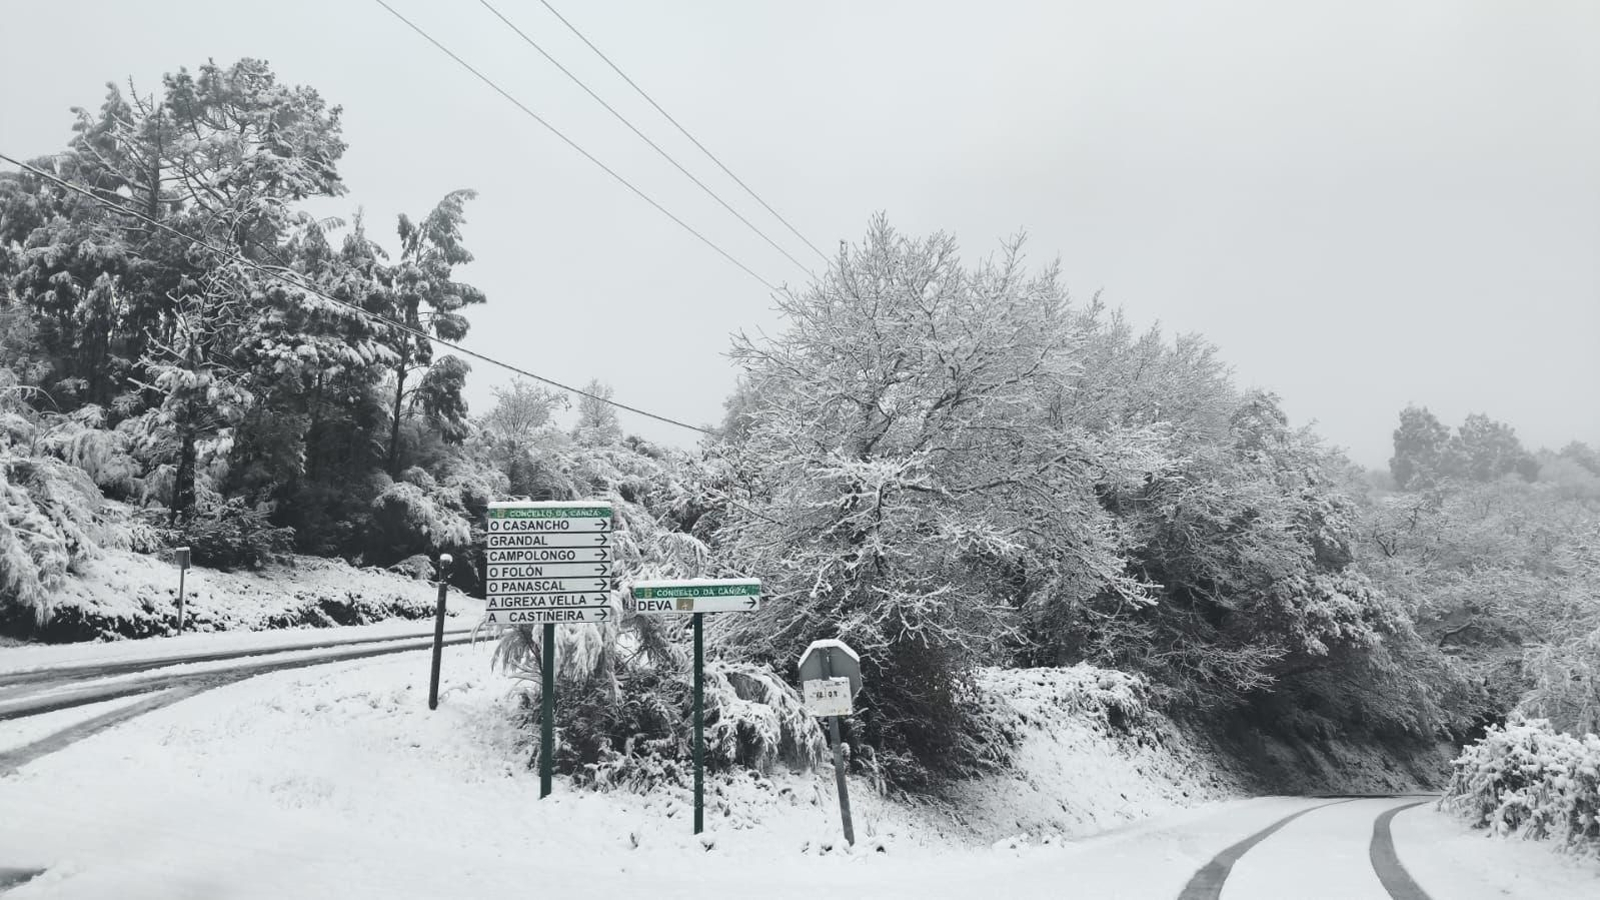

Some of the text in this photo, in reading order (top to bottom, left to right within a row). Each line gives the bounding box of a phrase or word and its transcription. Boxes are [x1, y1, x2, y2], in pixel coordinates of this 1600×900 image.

[509, 510, 553, 518] CONCELLO
[490, 520, 570, 531] O CASANCHO
[490, 536, 548, 546] GRANDAL
[490, 550, 576, 561] CAMPOLONGO
[490, 565, 542, 578] O FOLÓN
[489, 581, 565, 592] O PANASCAL
[488, 595, 586, 608] A IGREXA VELLA
[638, 600, 672, 611] DEVA
[488, 609, 584, 622] A CASTIÑEIRA
